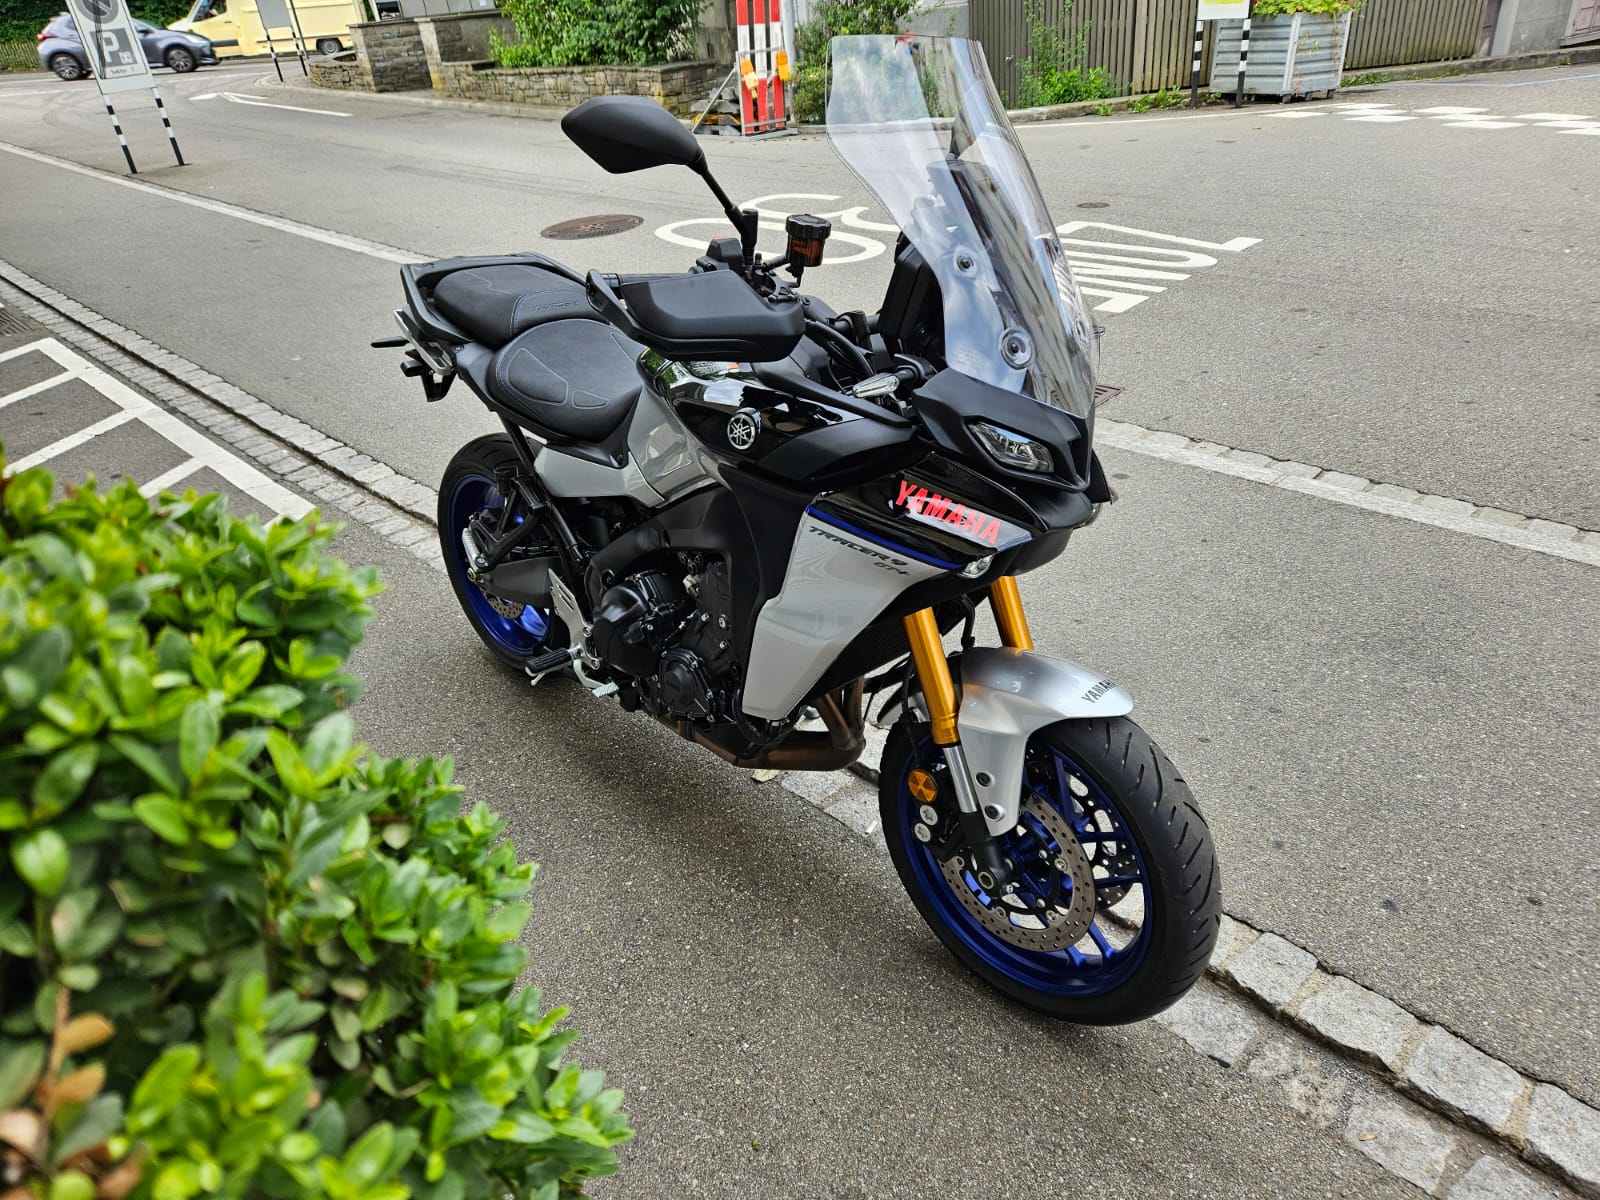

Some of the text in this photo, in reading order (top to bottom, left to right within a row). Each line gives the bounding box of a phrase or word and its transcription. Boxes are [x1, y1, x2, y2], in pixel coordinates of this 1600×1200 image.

[895, 479, 1002, 545] YAMAHA
[808, 525, 909, 567] TRACER 9
[1081, 678, 1119, 704] YAMAH
